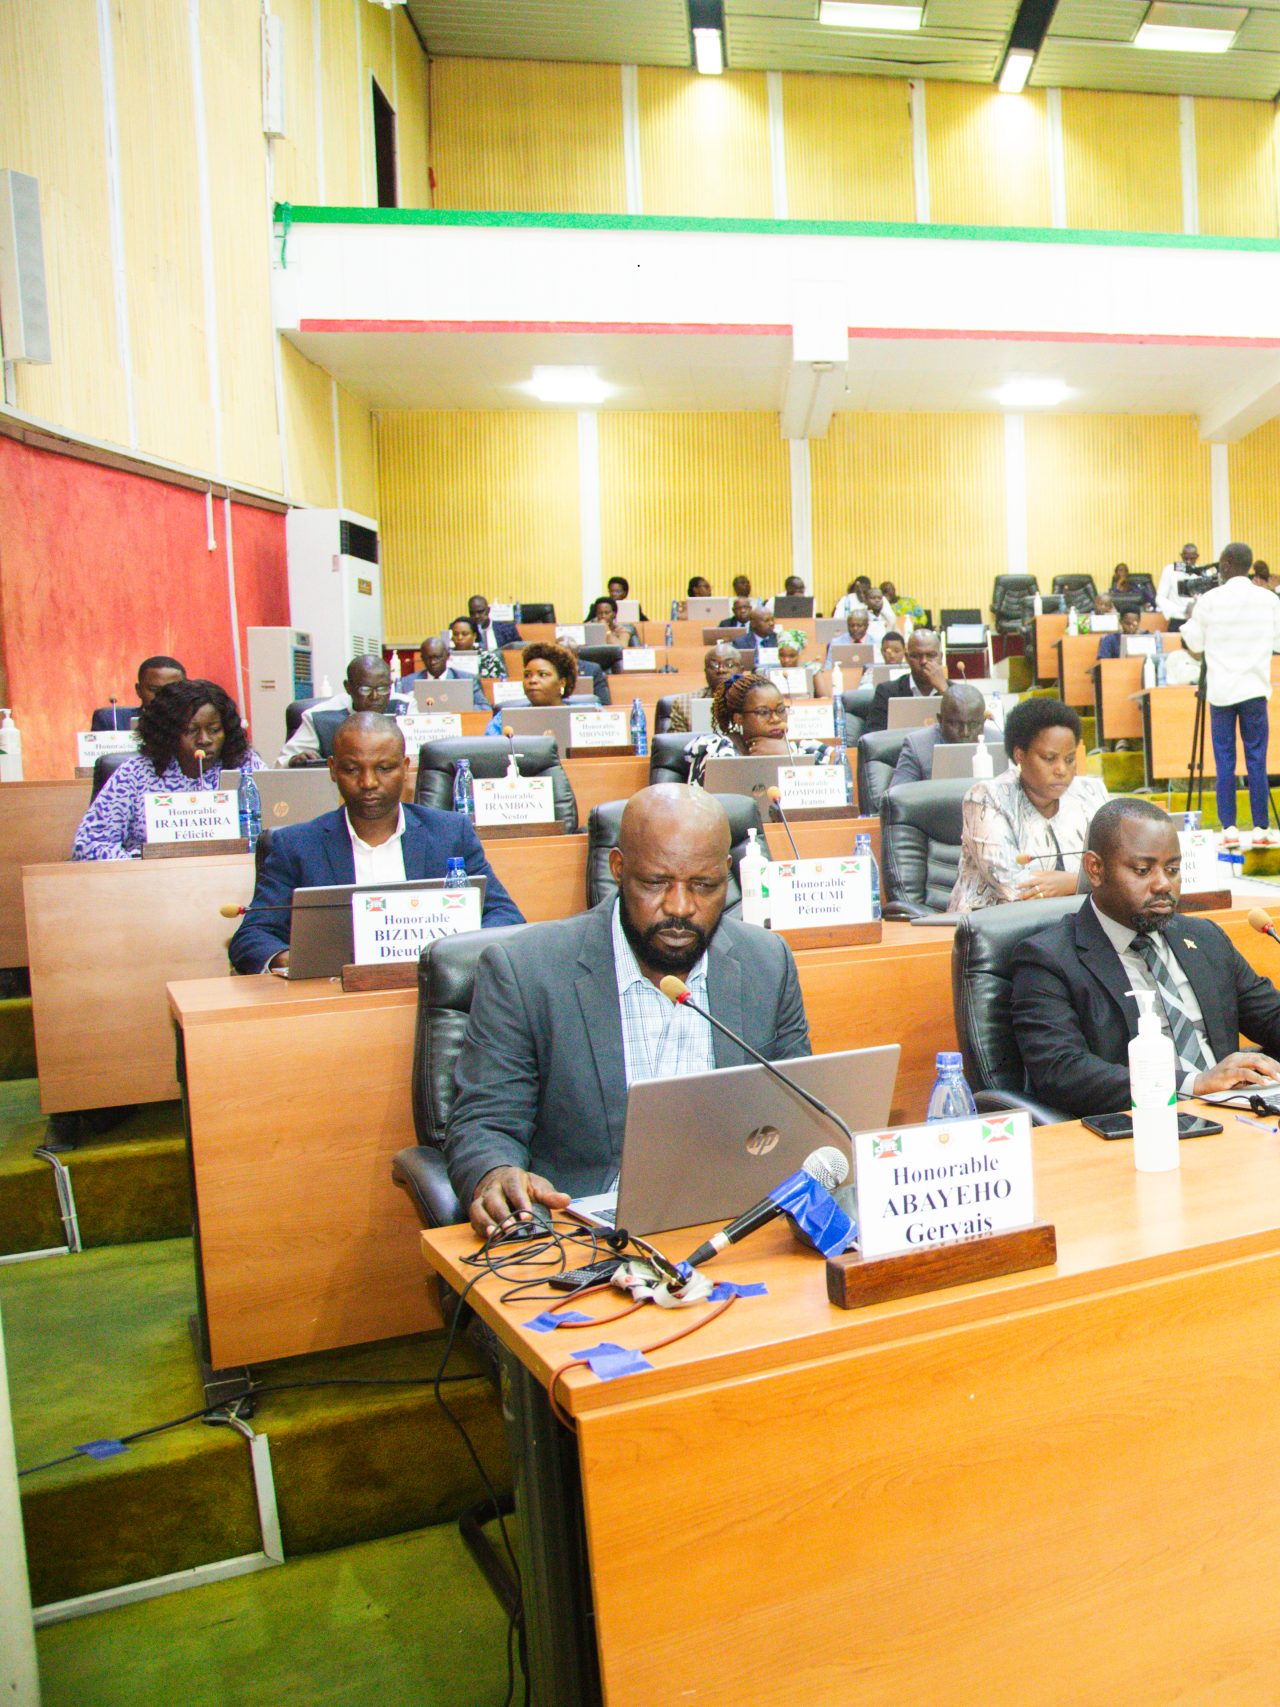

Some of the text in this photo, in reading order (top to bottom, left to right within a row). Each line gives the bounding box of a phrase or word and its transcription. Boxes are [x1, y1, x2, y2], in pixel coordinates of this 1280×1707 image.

[169, 806, 217, 816] Honorable
[485, 801, 543, 811] IRAMBONA
[155, 816, 231, 829] IRAHARIRA
[175, 829, 215, 840] Félicité
[792, 877, 846, 889] Honorable
[794, 890, 844, 902] BUCUMI
[798, 903, 841, 915] Pétronie
[384, 913, 450, 925] Honorable
[745, 1126, 779, 1155] hp
[894, 1155, 1000, 1186] Honorable
[882, 1178, 1012, 1219] ABAYEHO
[905, 1213, 993, 1244] Gervais
